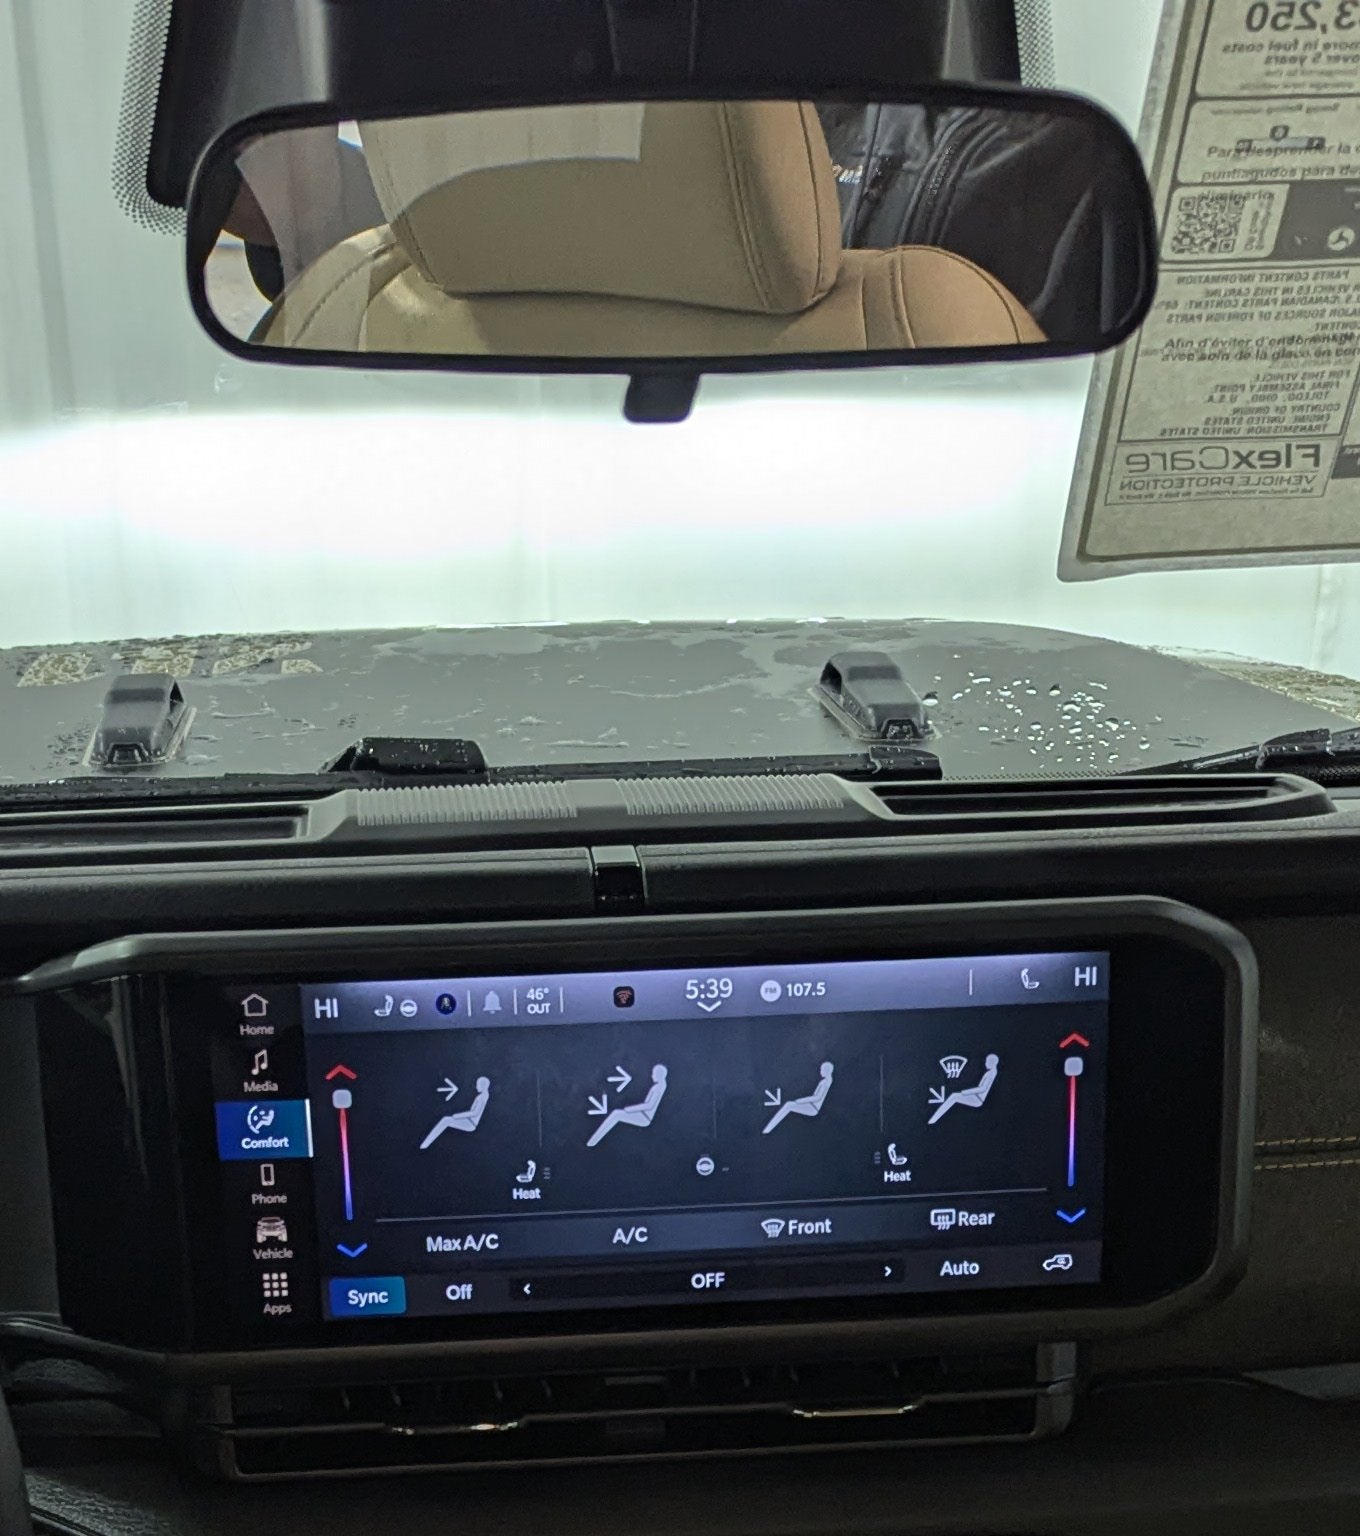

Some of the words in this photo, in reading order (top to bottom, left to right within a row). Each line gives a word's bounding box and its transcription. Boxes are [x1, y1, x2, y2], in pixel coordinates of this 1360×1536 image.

[1073, 966, 1098, 987] HI
[526, 987, 550, 1000] 46°
[685, 978, 733, 999] 5:39
[786, 982, 827, 997] 107.5
[314, 998, 339, 1019] HI
[526, 1001, 551, 1015] OUT
[240, 1024, 274, 1036] Home
[243, 1081, 278, 1092] Media
[241, 1136, 290, 1149] Comfort
[883, 1170, 911, 1183] Heat
[251, 1193, 288, 1205] Phone
[512, 1187, 541, 1200] Heat
[788, 1218, 832, 1235] Front
[958, 1211, 995, 1227] Rear
[426, 1236, 462, 1252] Max
[463, 1234, 499, 1251] A/C
[612, 1227, 648, 1245] A/C
[253, 1247, 293, 1260] Vehicle
[940, 1260, 980, 1276] Auto
[691, 1273, 726, 1289] OFF
[347, 1288, 389, 1306] Sync
[446, 1283, 473, 1300] Off
[263, 1302, 292, 1316] Apps
